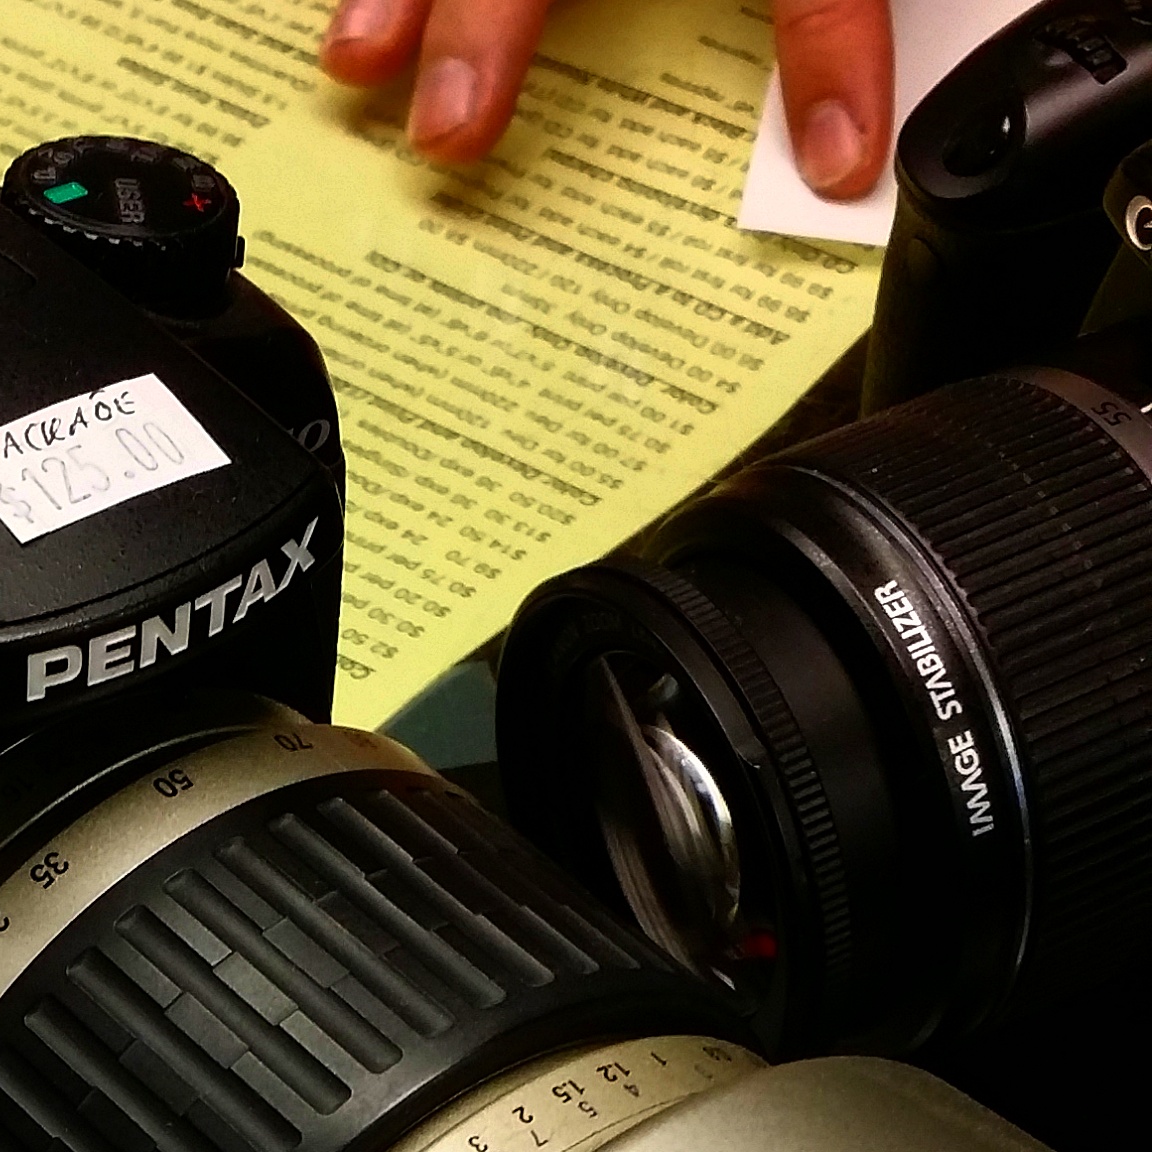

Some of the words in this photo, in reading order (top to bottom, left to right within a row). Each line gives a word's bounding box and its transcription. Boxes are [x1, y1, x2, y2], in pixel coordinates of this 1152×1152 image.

[113, 176, 146, 225] USER
[1090, 401, 1133, 426] 55
[27, 516, 319, 702] PENTAX
[873, 580, 963, 722] STABILIZER
[29, 851, 70, 890] 35
[152, 768, 194, 799] 50
[273, 731, 314, 752] 70
[946, 730, 995, 838] IMAGE
[511, 1105, 535, 1126] 2
[530, 1130, 549, 1148] 7
[577, 1100, 600, 1119] 5
